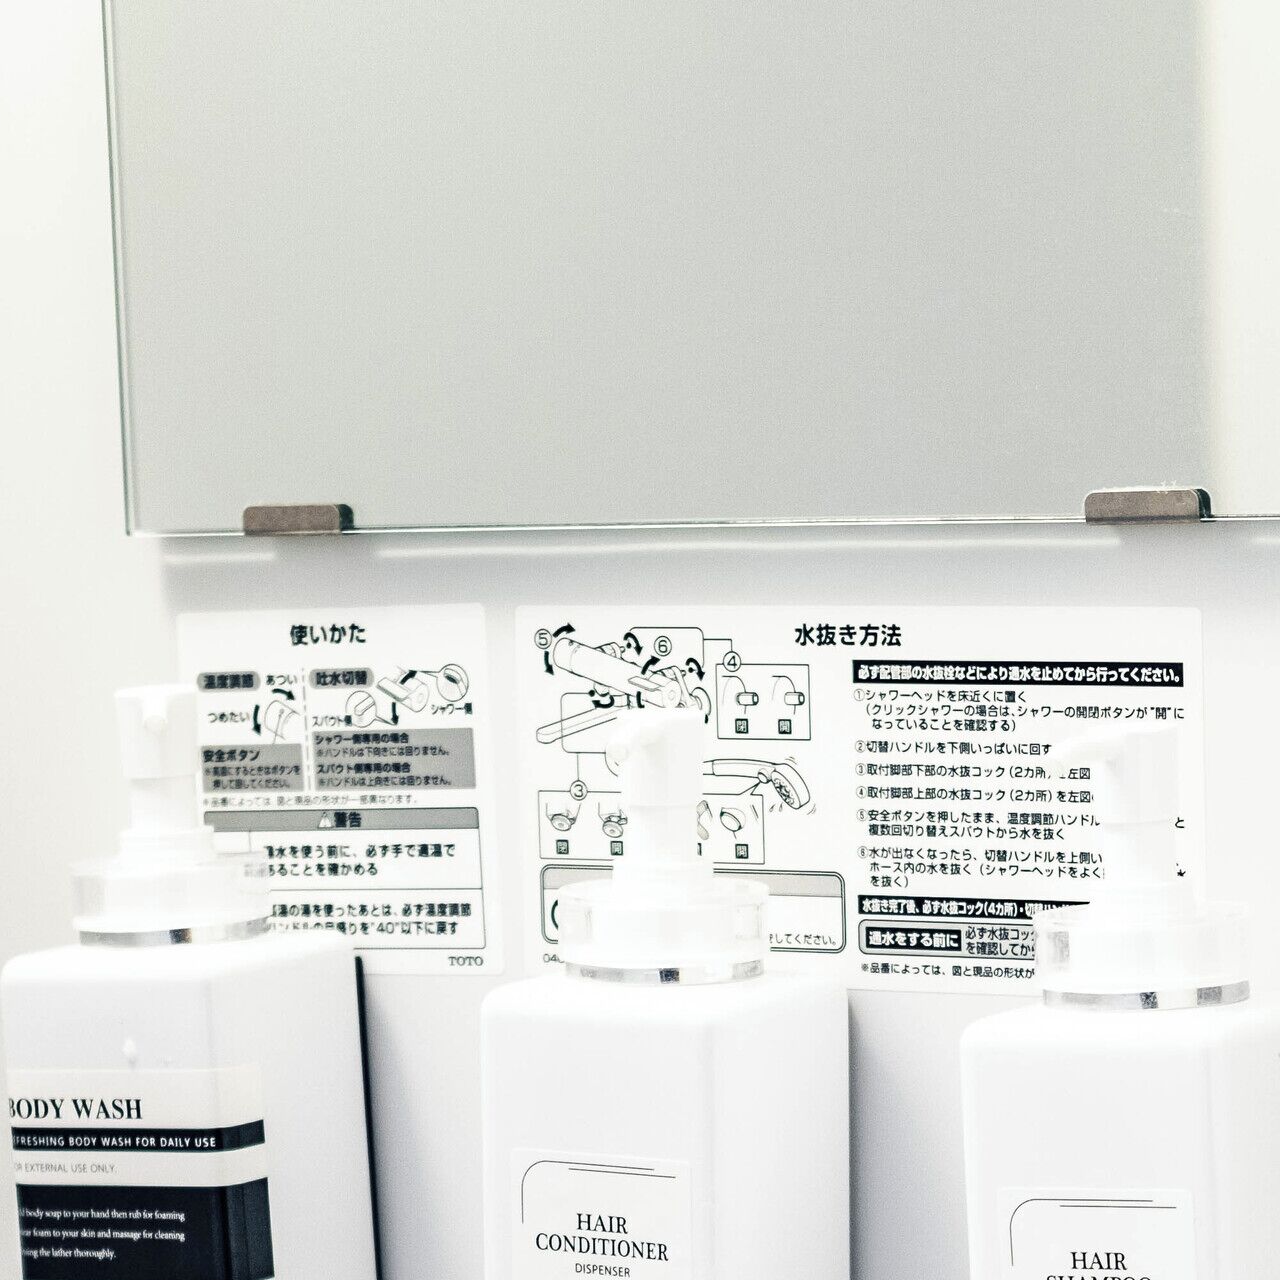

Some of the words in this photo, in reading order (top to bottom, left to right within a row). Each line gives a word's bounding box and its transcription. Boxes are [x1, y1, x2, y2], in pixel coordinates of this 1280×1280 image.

[290, 624, 366, 646] 使いかた
[794, 623, 902, 647] 水抜き方法
[266, 674, 297, 685] あつい
[207, 711, 250, 723] つめたい
[334, 811, 361, 828] 警告
[448, 956, 483, 967] TOTO
[9, 1097, 65, 1119] BODY
[71, 1098, 143, 1119] WASH
[69, 1136, 97, 1147] BODY
[101, 1137, 131, 1147] WASH
[135, 1137, 156, 1147] FOR
[160, 1137, 191, 1148] DAILY
[195, 1137, 216, 1148] USE
[24, 1162, 68, 1173] EXTERNAL
[71, 1163, 88, 1173] USE
[90, 1163, 118, 1174] ONLY.
[26, 1208, 43, 1220] body
[45, 1210, 62, 1220] soap
[63, 1210, 71, 1218] to
[72, 1210, 89, 1220] your
[91, 1208, 110, 1218] hand
[111, 1209, 128, 1219] then
[129, 1209, 142, 1219] rub
[143, 1209, 153, 1219] for
[154, 1210, 185, 1222] foaming
[576, 1213, 628, 1235] HAIR
[33, 1227, 51, 1237] foam
[53, 1229, 60, 1237] to
[62, 1229, 79, 1240] your
[80, 1228, 95, 1238] skin
[97, 1228, 111, 1238] and
[112, 1231, 141, 1242] massage
[143, 1229, 153, 1239] for
[154, 1230, 185, 1242] cleaning
[40, 1246, 51, 1257] the
[52, 1247, 72, 1257] lather
[74, 1247, 116, 1261] thoroughly.
[536, 1232, 669, 1261] CONDITIONER
[1070, 1251, 1128, 1271] HAIR
[575, 1262, 630, 1278] DISPENSER
